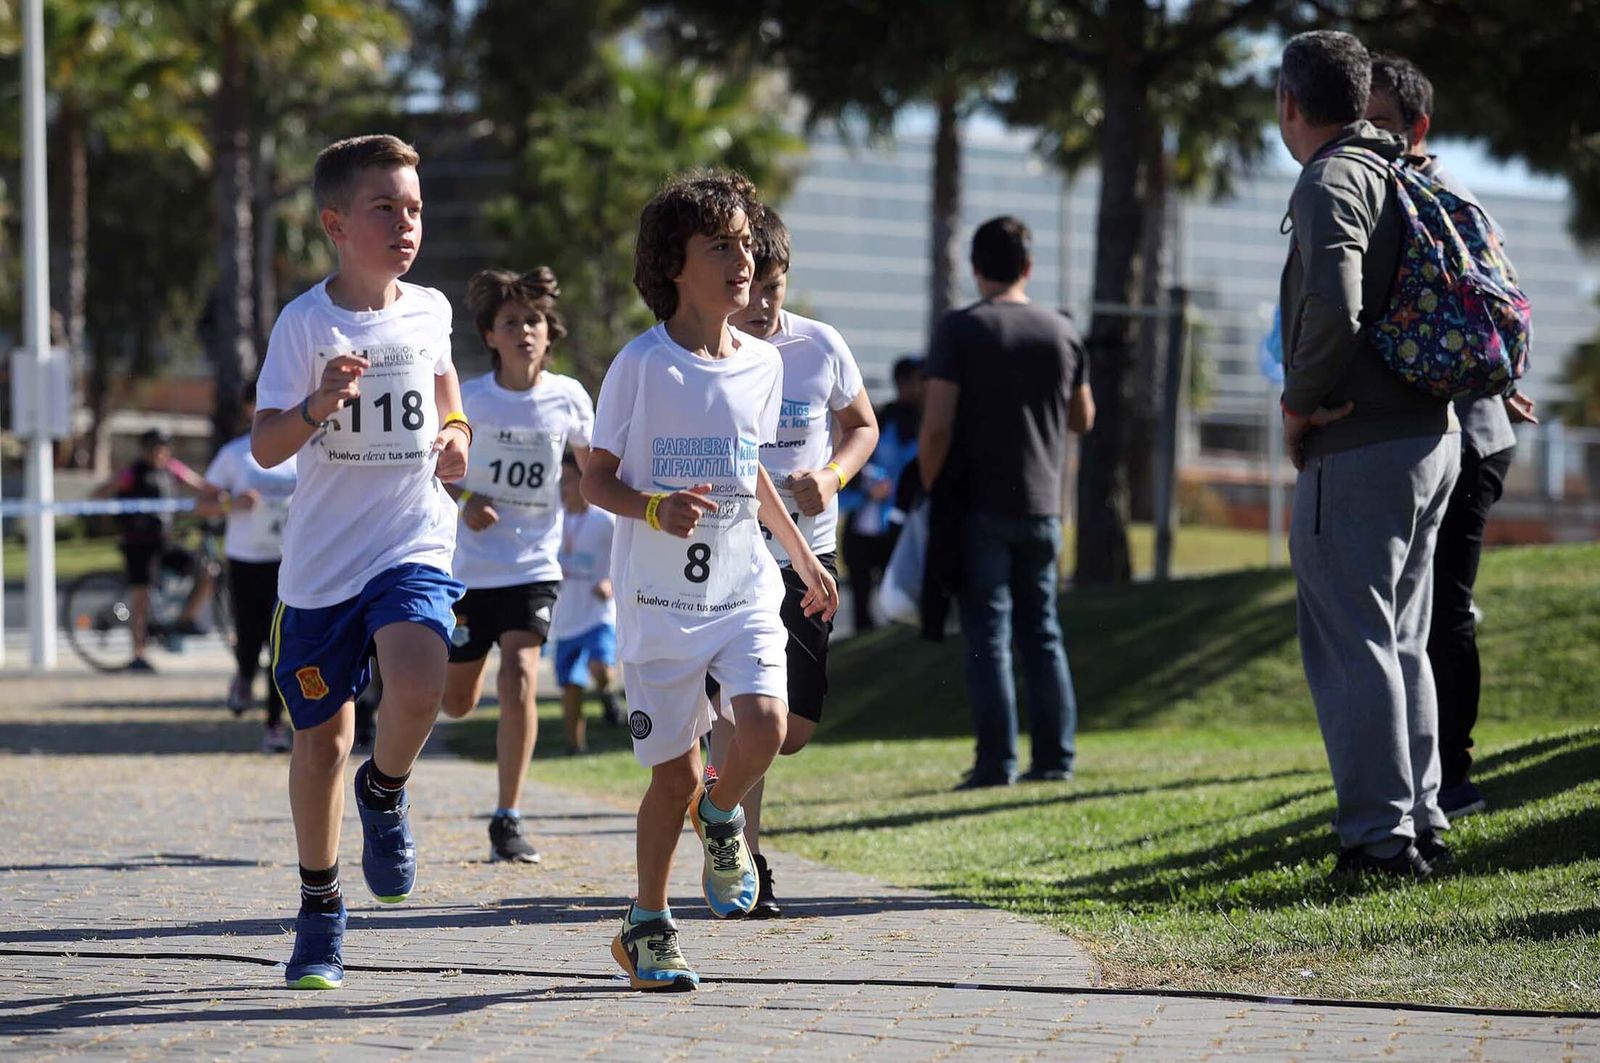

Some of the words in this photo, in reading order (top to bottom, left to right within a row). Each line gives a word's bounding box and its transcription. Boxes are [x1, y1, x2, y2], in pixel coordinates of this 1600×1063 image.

[383, 353, 414, 361] HUELVA
[780, 404, 810, 417] kilos
[328, 449, 361, 461] Huelva
[362, 450, 386, 461] eleva
[388, 449, 403, 460] tus
[652, 437, 733, 456] CARRERA
[488, 458, 545, 489] 108
[652, 457, 735, 477] INFANTIL
[684, 542, 712, 584] 8
[636, 593, 669, 608] Huelva
[670, 598, 695, 612] eleva
[696, 602, 708, 613] tus
